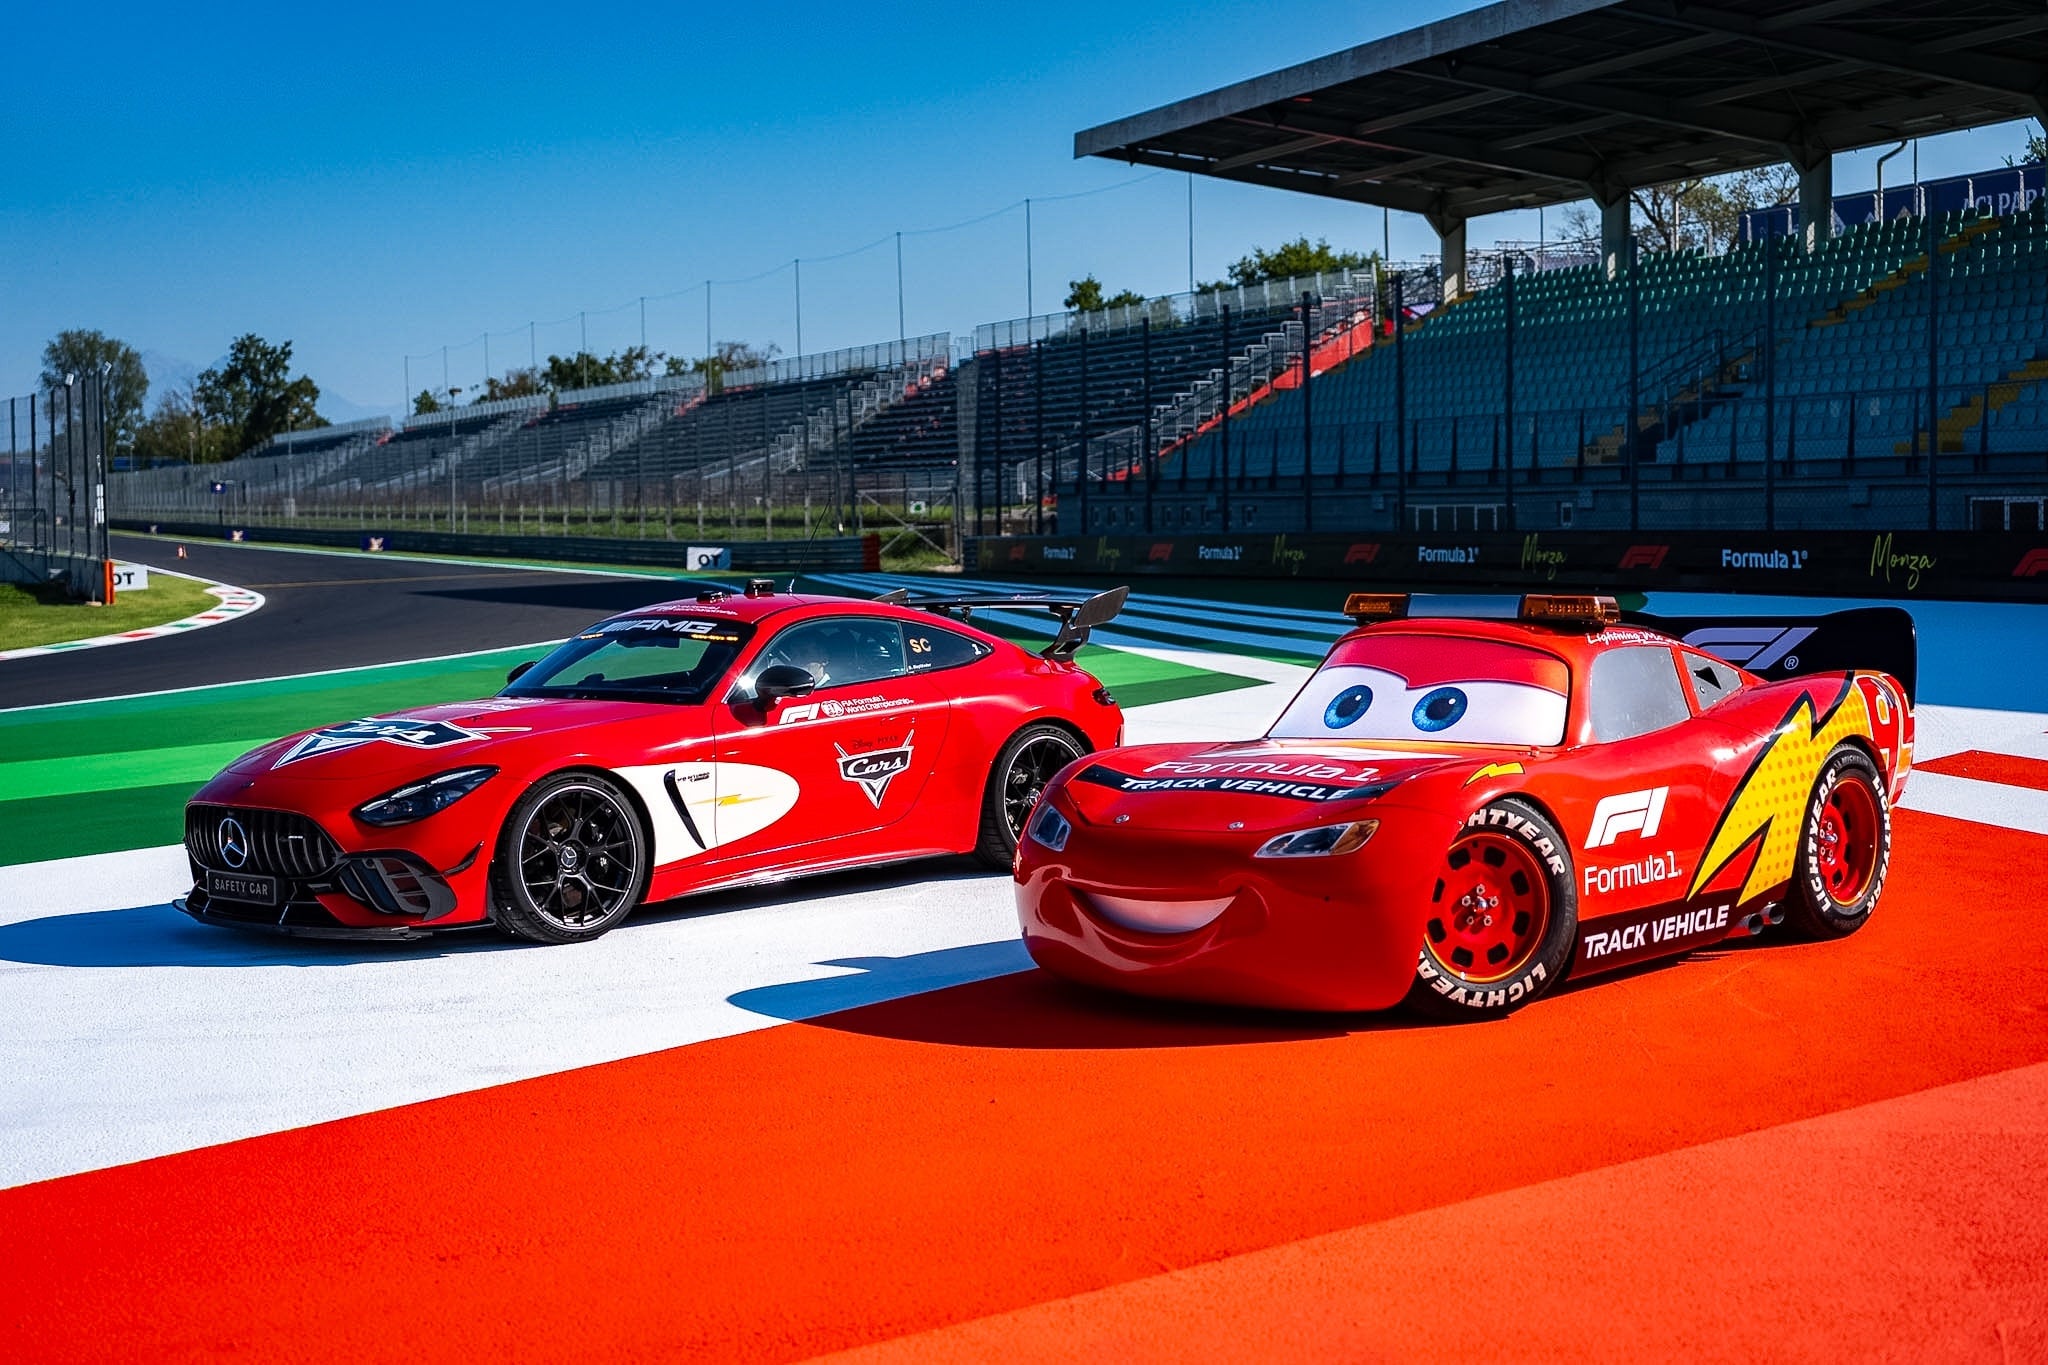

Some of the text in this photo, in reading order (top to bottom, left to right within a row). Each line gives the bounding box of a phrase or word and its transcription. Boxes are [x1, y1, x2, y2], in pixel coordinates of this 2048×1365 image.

[1199, 545, 1233, 560] Formula
[1418, 546, 1465, 562] Formula
[1722, 549, 1788, 568] Formula
[1870, 533, 1937, 590] Monza
[909, 637, 931, 654] SC
[847, 756, 904, 776] Cars
[1143, 761, 1345, 779] Formula
[1121, 778, 1354, 800] TRACK VEHICLE
[1468, 808, 1566, 876] HTYEAR
[1807, 768, 1837, 913] LIGHTYEAR
[1584, 854, 1665, 896] Formula
[214, 878, 268, 895] SAFETY CAR
[1584, 904, 1730, 959] TRACK VEHICLE
[1417, 951, 1547, 1007] LIGHTYEA
